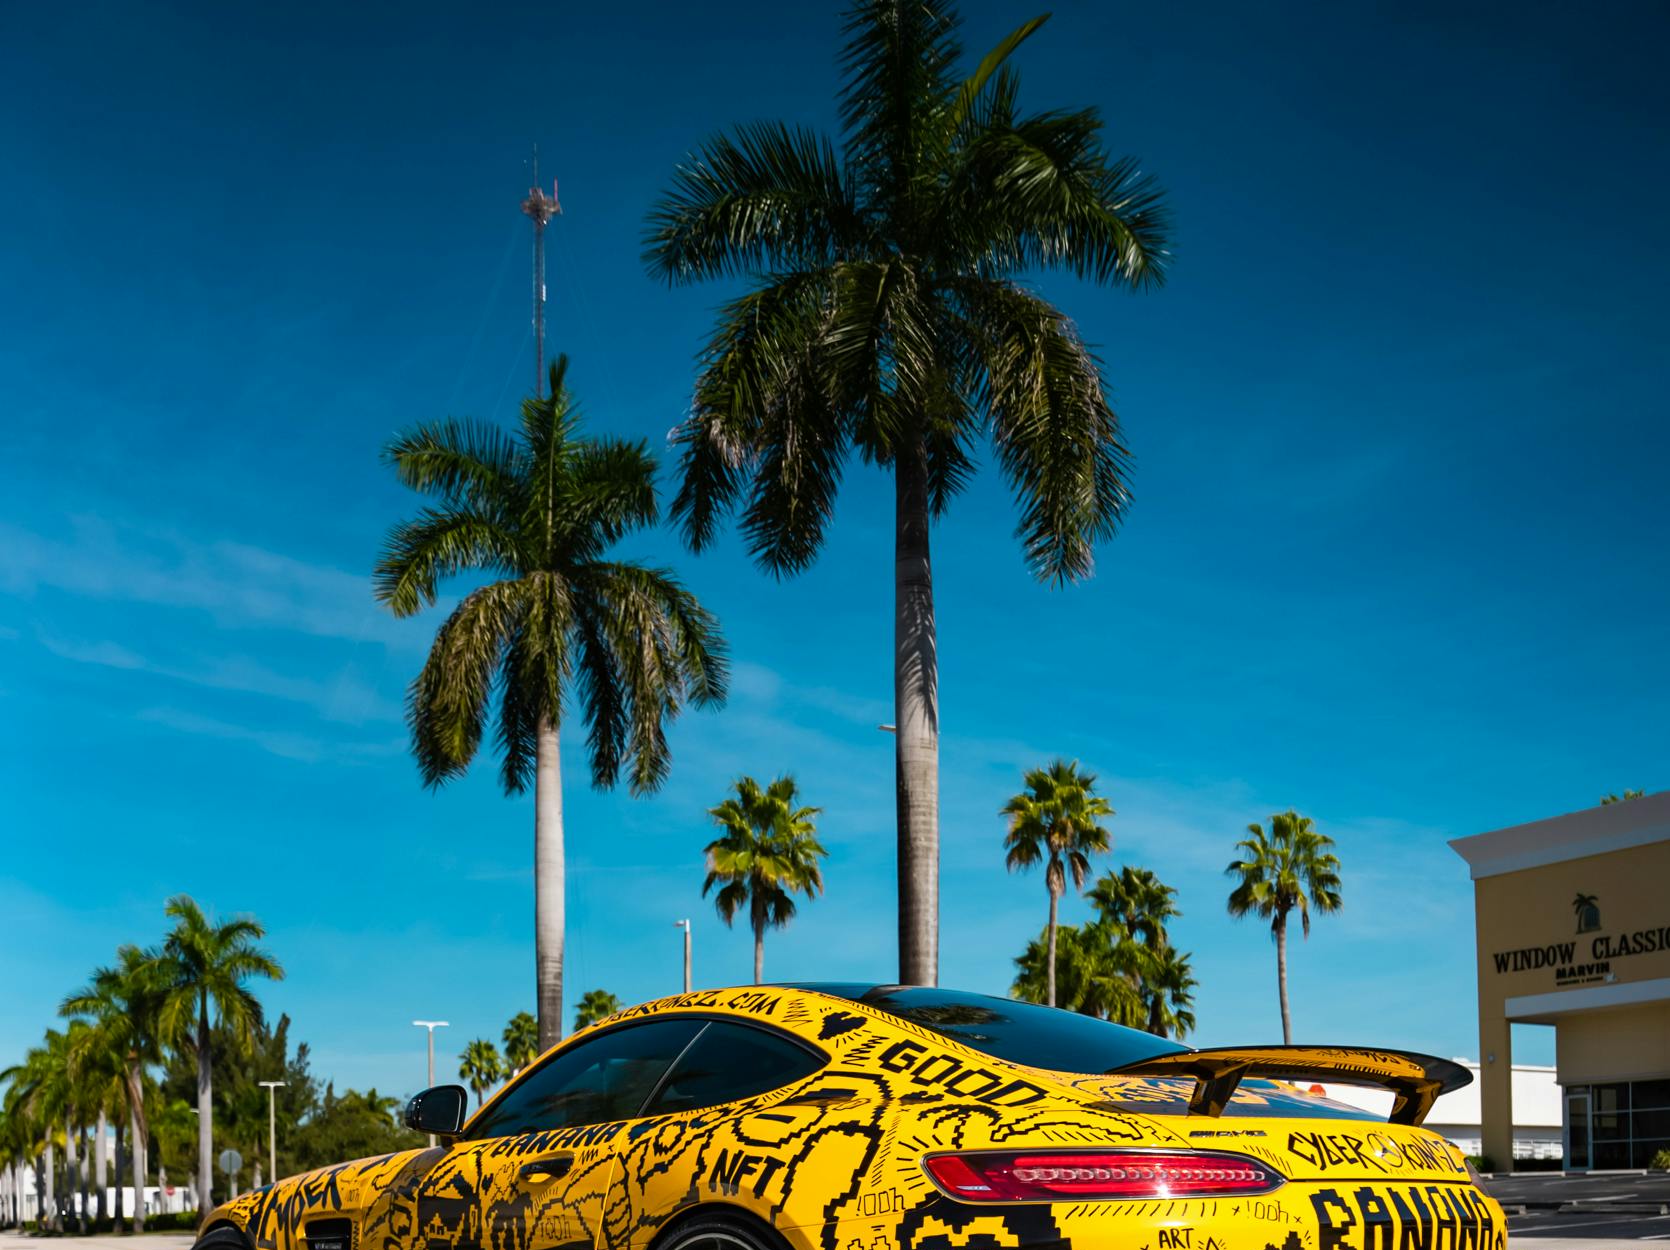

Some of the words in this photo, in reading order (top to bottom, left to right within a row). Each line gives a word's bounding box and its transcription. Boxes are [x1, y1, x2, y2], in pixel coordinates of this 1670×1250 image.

[1494, 942, 1576, 974] WINDOW
[1556, 962, 1609, 980] MARVIN
[877, 1039, 1050, 1107] GOOD
[491, 1122, 628, 1157] BANANA
[1288, 1131, 1388, 1174] CYBER
[709, 1148, 787, 1200] NFT
[1158, 1227, 1194, 1250] ART
